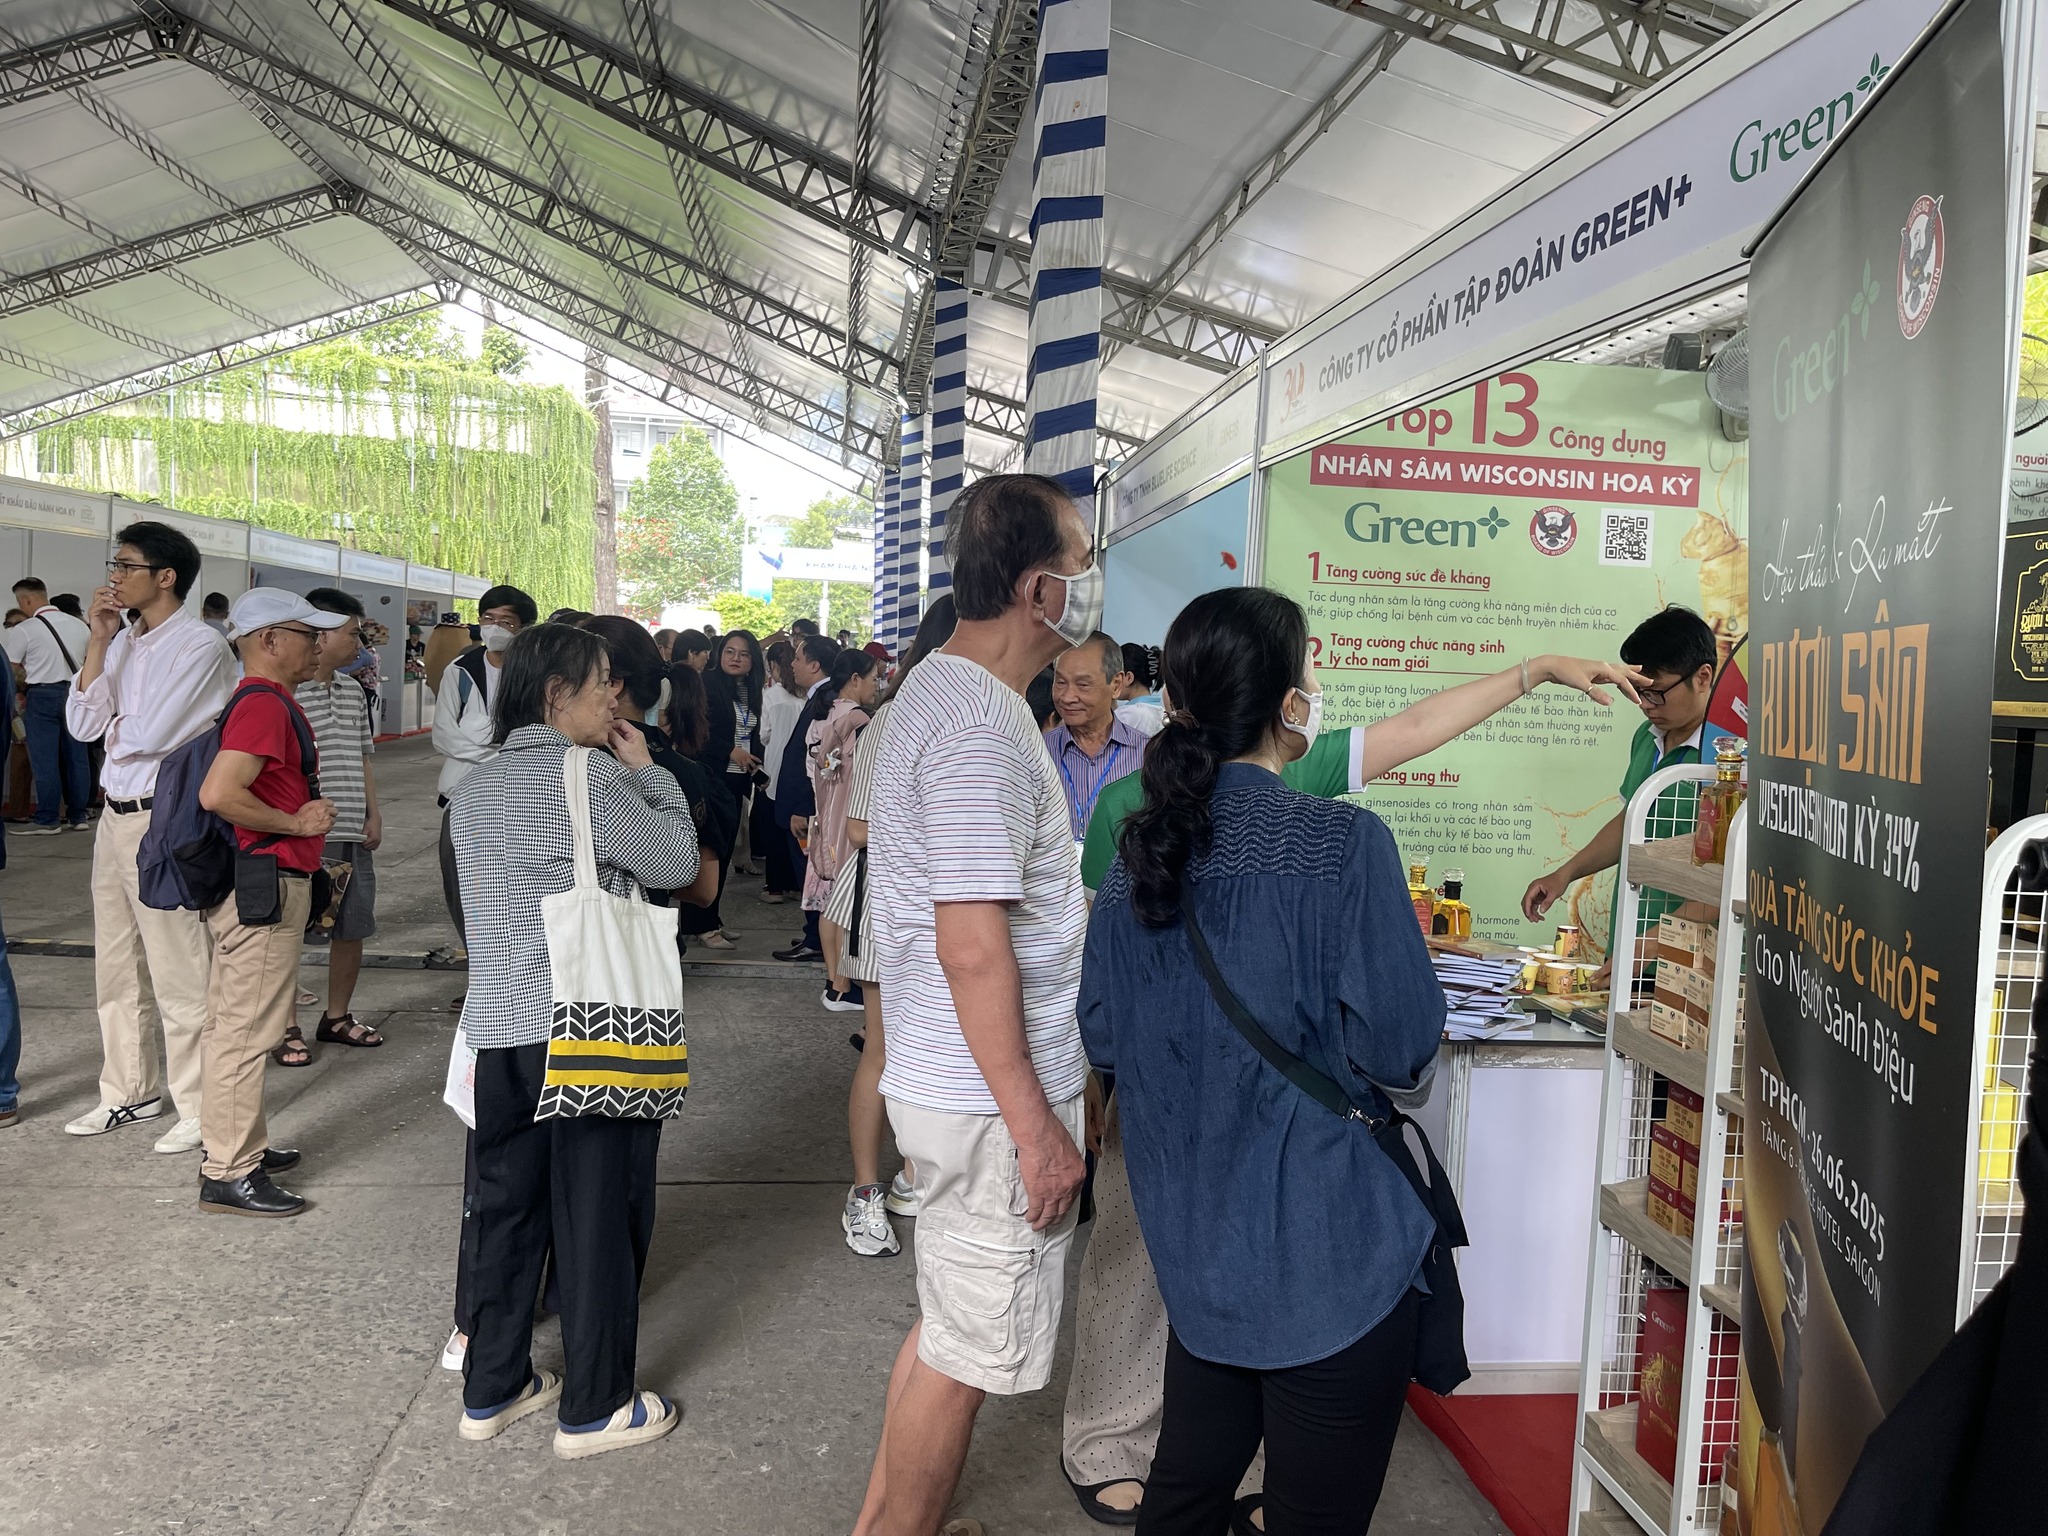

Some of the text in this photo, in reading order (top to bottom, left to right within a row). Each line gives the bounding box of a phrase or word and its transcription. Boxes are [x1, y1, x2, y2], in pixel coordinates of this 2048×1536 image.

[1319, 173, 1692, 393] CÔNG TY CỔ PHẦN TẬP ĐOÀN GREEN+
[1773, 313, 1850, 423] Green
[1472, 372, 1540, 447] 13
[1549, 425, 1605, 458] Công
[1612, 429, 1667, 462] dụng
[1318, 453, 1693, 497] NHÂN SÂM WISCONSIN HOA KỲ
[1344, 502, 1477, 549] Green
[1308, 551, 1320, 581] 1
[1326, 564, 1358, 582] Tăng
[1450, 569, 1490, 589] kháng
[1329, 591, 1355, 606] dụng
[1411, 595, 1420, 606] là
[1330, 607, 1353, 620] giúp
[1392, 609, 1404, 621] lại
[1461, 615, 1473, 624] và
[1476, 615, 1494, 625] các
[1307, 636, 1323, 667] 2
[1331, 633, 1362, 650] Tăng
[1443, 641, 1475, 656] năng
[1479, 639, 1505, 654] sinh
[1329, 650, 1341, 669] lý
[1345, 651, 1368, 666] cho
[1372, 657, 1400, 668] nam
[1358, 683, 1382, 696] giúp
[1593, 708, 1613, 718] kinh
[1412, 768, 1461, 786] ung thư
[1366, 797, 1430, 809] ginsenosides
[1435, 799, 1447, 809] có
[1452, 800, 1478, 813] trong
[1395, 811, 1407, 822] lại
[1443, 814, 1455, 824] và
[1458, 814, 1476, 825] các
[1513, 819, 1532, 830] ung
[1424, 827, 1442, 838] chu
[1497, 831, 1509, 840] và
[1513, 829, 1531, 841] làm
[1853, 795, 1880, 870] KỲ
[1883, 812, 1919, 893] 34%
[1496, 847, 1514, 857] ung
[1476, 912, 1520, 926] hormone
[1750, 866, 1939, 1035] QUÀ TẶNG SỨC KHỎE
[1755, 933, 1783, 986] Cho
[1824, 985, 1868, 1063] Sành
[1873, 1018, 1914, 1105] Điệu
[1760, 1066, 1885, 1262] TPHCM 26.06.2025
[1760, 1117, 1787, 1161] TẦNG
[1788, 1146, 1794, 1169] 6
[1816, 1195, 1843, 1254] HOTEL
[1845, 1236, 1881, 1307] SAIGON
